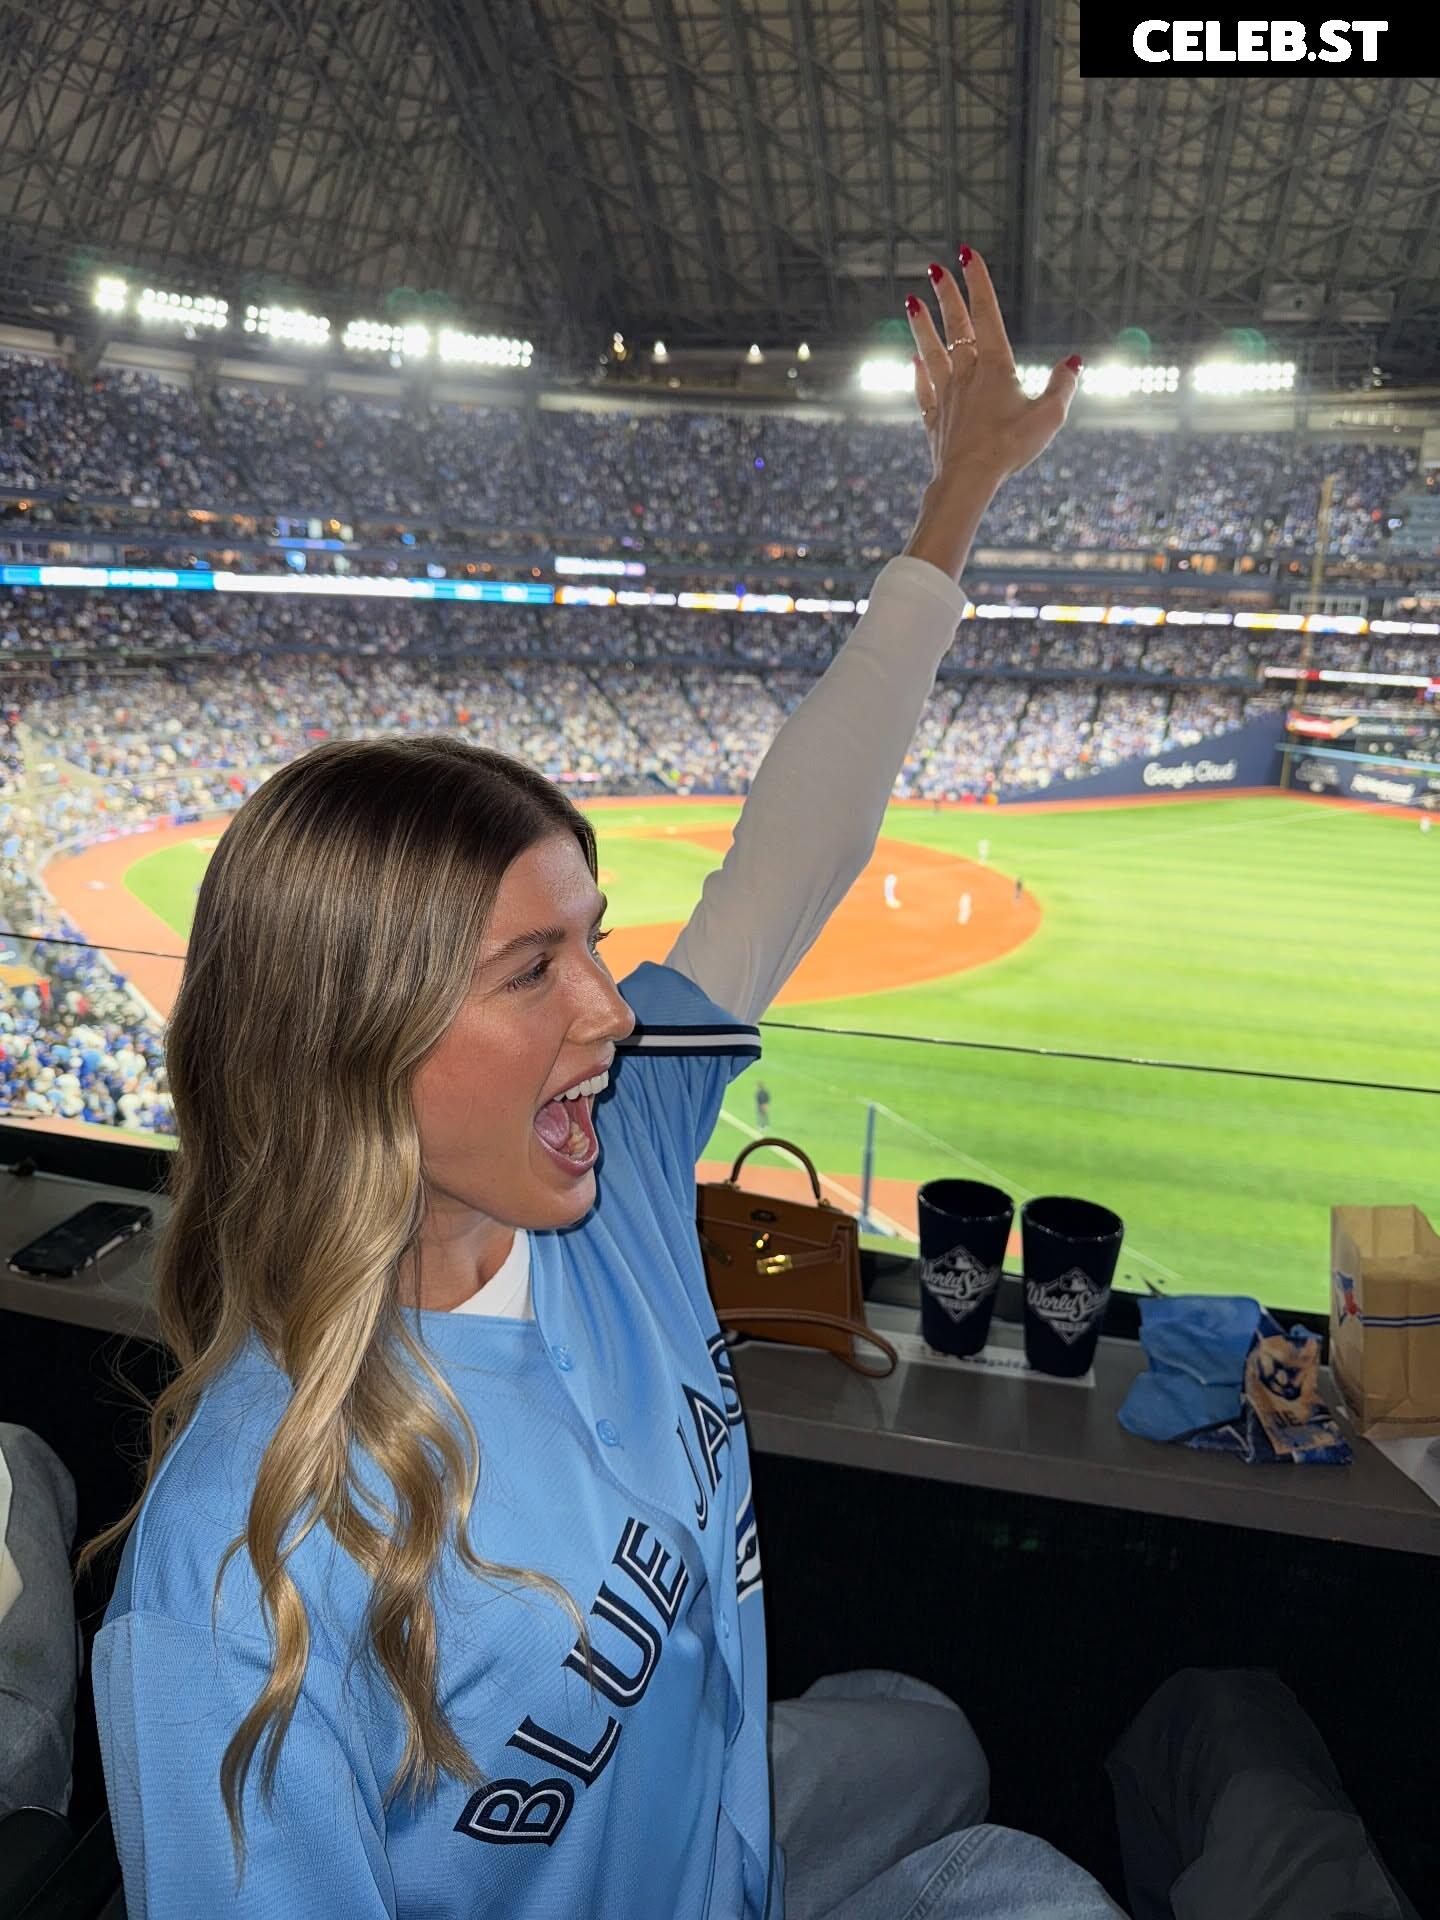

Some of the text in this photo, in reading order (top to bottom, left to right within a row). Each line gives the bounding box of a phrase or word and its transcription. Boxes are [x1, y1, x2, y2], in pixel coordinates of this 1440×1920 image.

[1143, 759, 1238, 789] Google Cloud
[920, 1261, 965, 1288] World
[1025, 1280, 1079, 1311] World
[453, 1515, 691, 1848] BLUE
